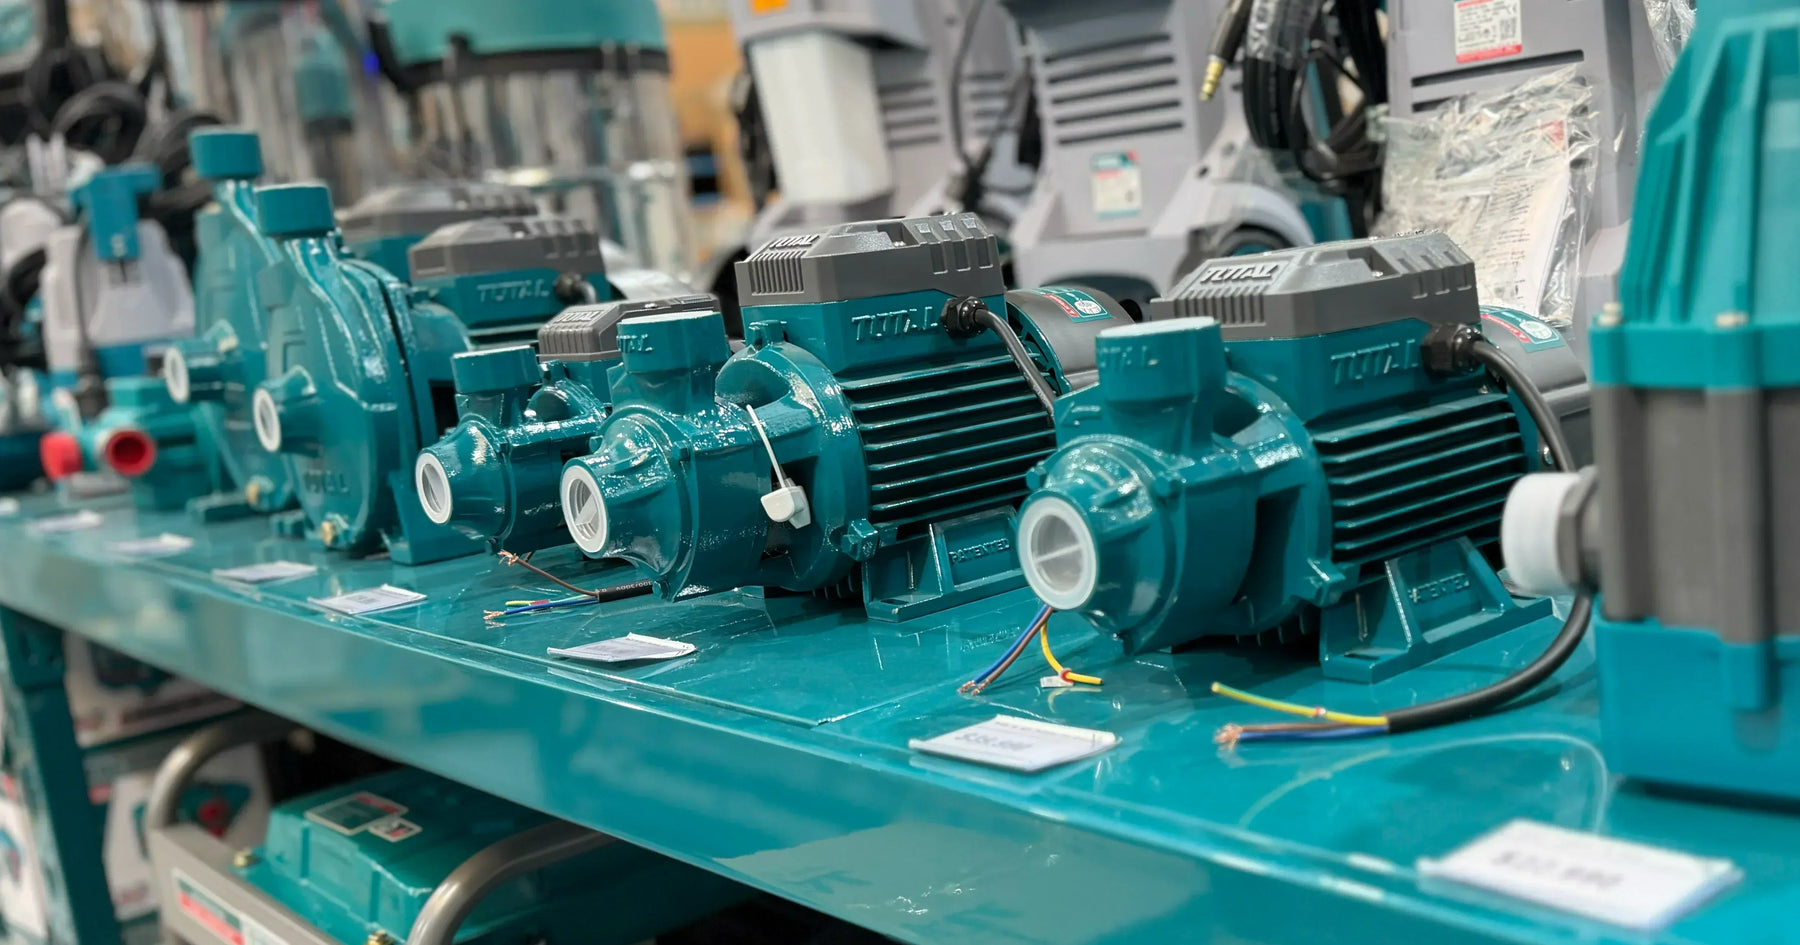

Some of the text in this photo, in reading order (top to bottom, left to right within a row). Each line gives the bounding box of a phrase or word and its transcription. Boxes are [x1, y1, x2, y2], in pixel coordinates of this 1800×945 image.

[769, 234, 820, 250] TOTAL
[1200, 264, 1279, 284] TOTAL
[477, 279, 550, 302] TOTAL
[851, 306, 938, 341] TOTAL
[1330, 339, 1419, 384] TOTAL
[948, 538, 1011, 563] PATENTED
